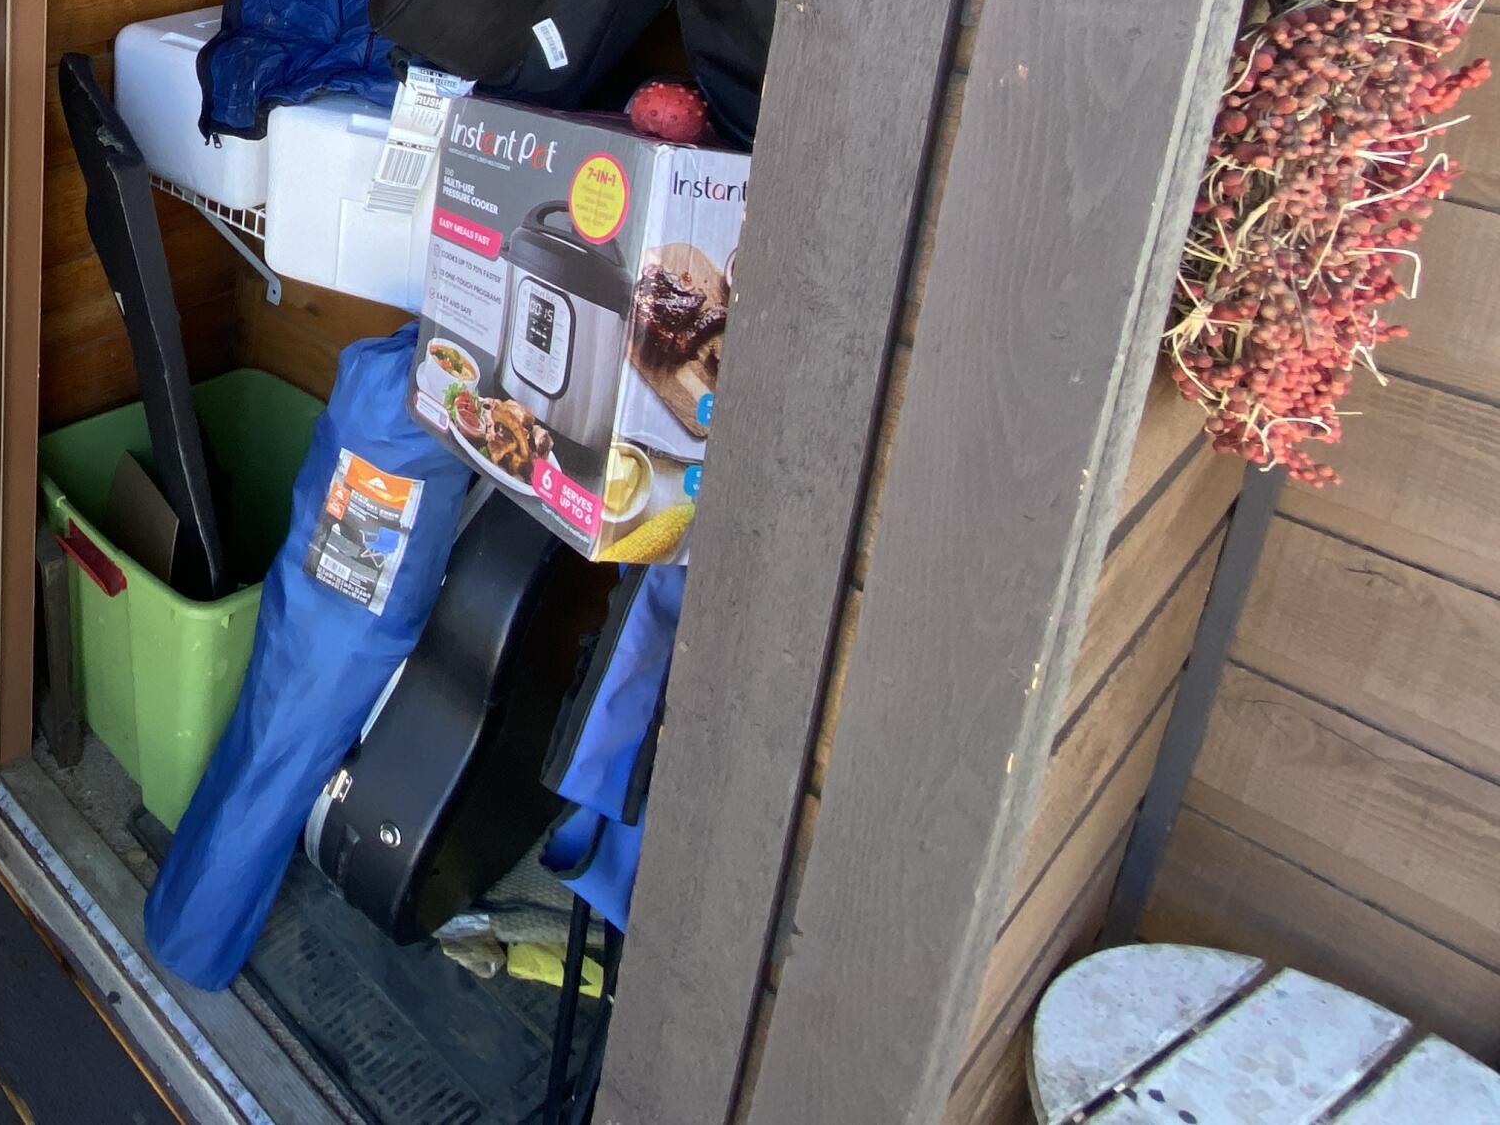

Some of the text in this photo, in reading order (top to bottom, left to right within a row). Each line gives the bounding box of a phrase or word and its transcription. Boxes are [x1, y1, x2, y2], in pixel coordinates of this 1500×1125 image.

[415, 95, 443, 109] RUSH
[450, 113, 516, 161] Instant
[518, 132, 558, 173] Pot
[443, 175, 476, 195] MULTI-USE
[587, 167, 617, 187] 7-IN-1
[442, 186, 499, 215] PRESSURE COOKER
[438, 217, 491, 247] EASY MEALS FAST
[541, 469, 553, 491] 6
[560, 495, 571, 509] UP
[571, 503, 584, 519] TO
[584, 514, 592, 525] 6
[561, 484, 594, 513] SERVES
